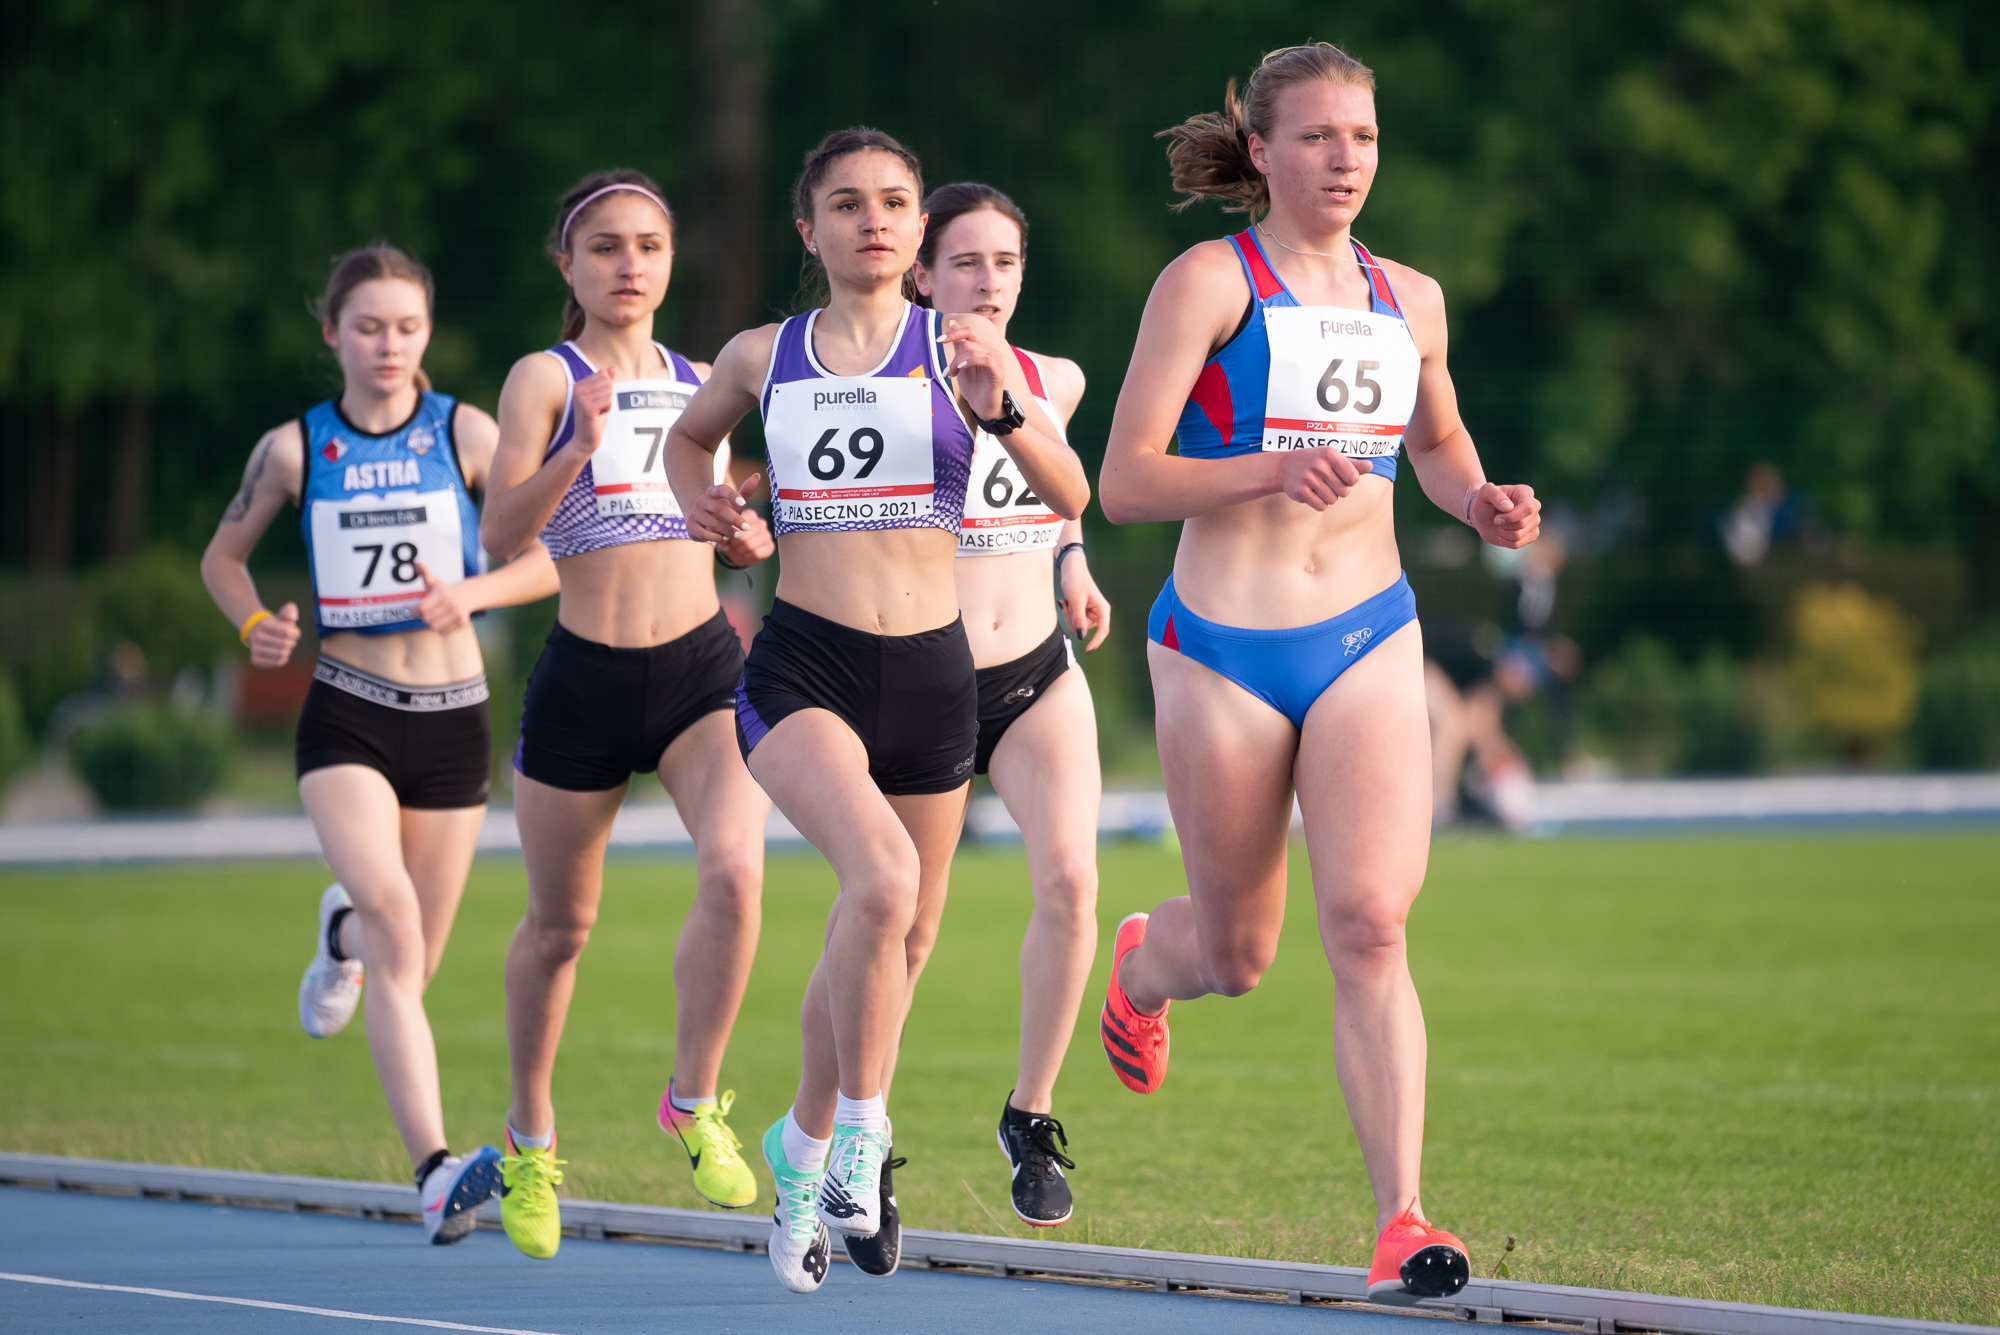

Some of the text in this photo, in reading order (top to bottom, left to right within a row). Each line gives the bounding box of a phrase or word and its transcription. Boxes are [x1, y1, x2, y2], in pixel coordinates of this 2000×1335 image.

[1320, 319, 1372, 339] purella
[1316, 358, 1382, 414] 65
[814, 388, 877, 411] purella
[1306, 422, 1335, 431] PZLA
[634, 427, 663, 473] 7
[808, 427, 885, 481] 69
[1369, 441, 1391, 455] 2021
[343, 458, 422, 491] ASTRA
[802, 490, 829, 499] PZLA
[610, 499, 677, 513] PIASECZN
[788, 502, 917, 521] PIASECZNO 2021
[975, 519, 1001, 527] PZLA
[960, 530, 1028, 547] IASECZNO
[353, 542, 419, 588] 78
